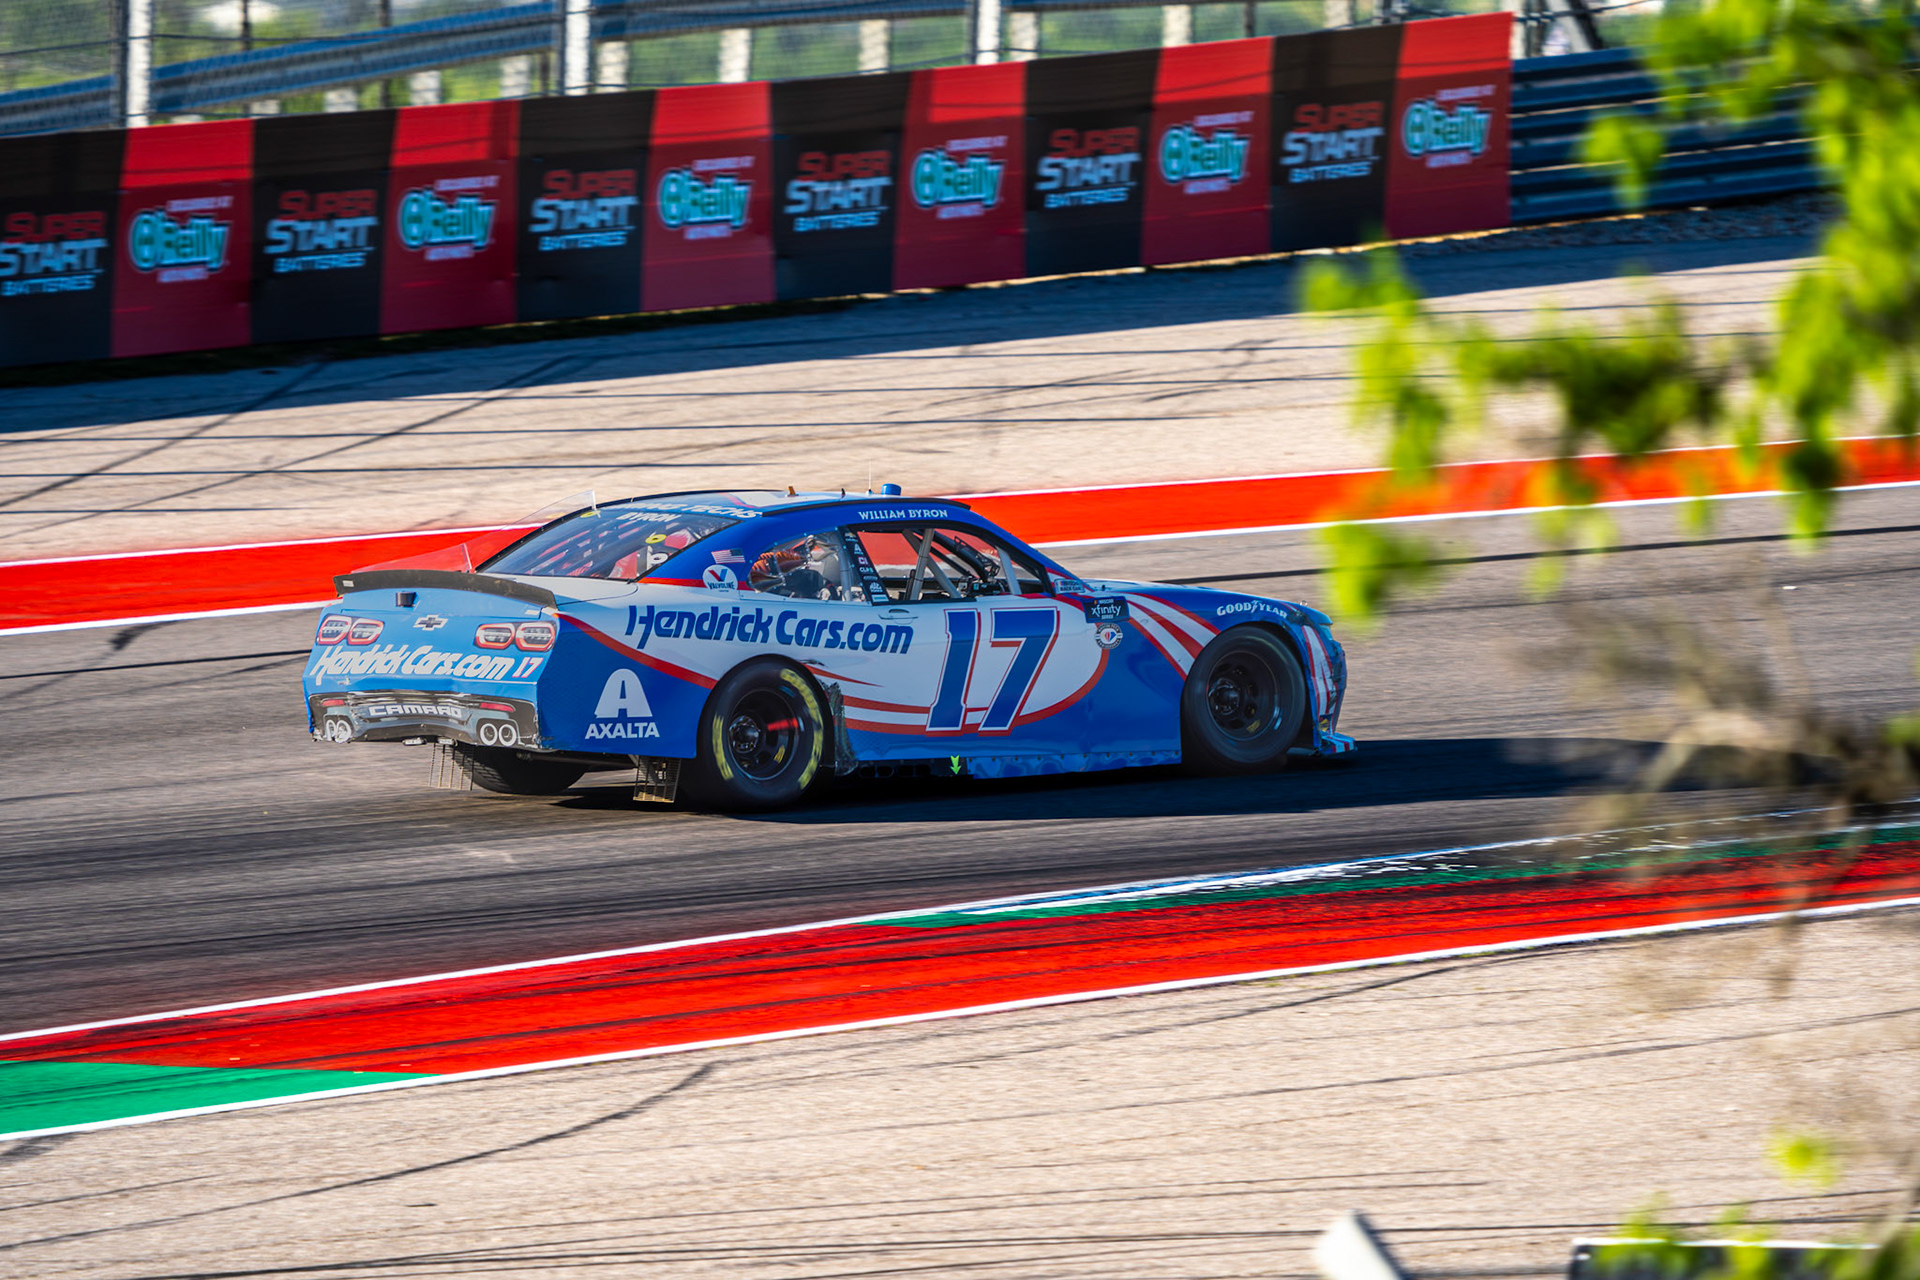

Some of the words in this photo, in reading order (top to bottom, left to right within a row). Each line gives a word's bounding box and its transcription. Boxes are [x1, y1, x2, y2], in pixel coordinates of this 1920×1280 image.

[1293, 101, 1384, 133] SUPER
[1047, 127, 1140, 158] SUPER
[1279, 127, 1384, 165] START
[796, 150, 891, 182] SUPER
[1035, 153, 1141, 190] START
[541, 169, 637, 201] SUPER
[783, 176, 893, 214] START
[277, 189, 378, 221] SUPER
[528, 196, 639, 232] START
[4, 211, 107, 243] SUPER
[263, 216, 380, 254] START
[858, 509, 906, 520] WILLIAM
[908, 508, 948, 518] BYRON
[707, 581, 735, 590] VALVOLINE
[1091, 604, 1121, 617] xfinity
[1216, 600, 1288, 619] GOODYEAR
[625, 605, 914, 654] HendrickCars.com
[310, 644, 515, 685] HendrickCars.com
[512, 656, 544, 679] 17
[926, 606, 1060, 737] 17
[369, 704, 462, 718] CAMARO
[585, 722, 660, 739] AXALTA
